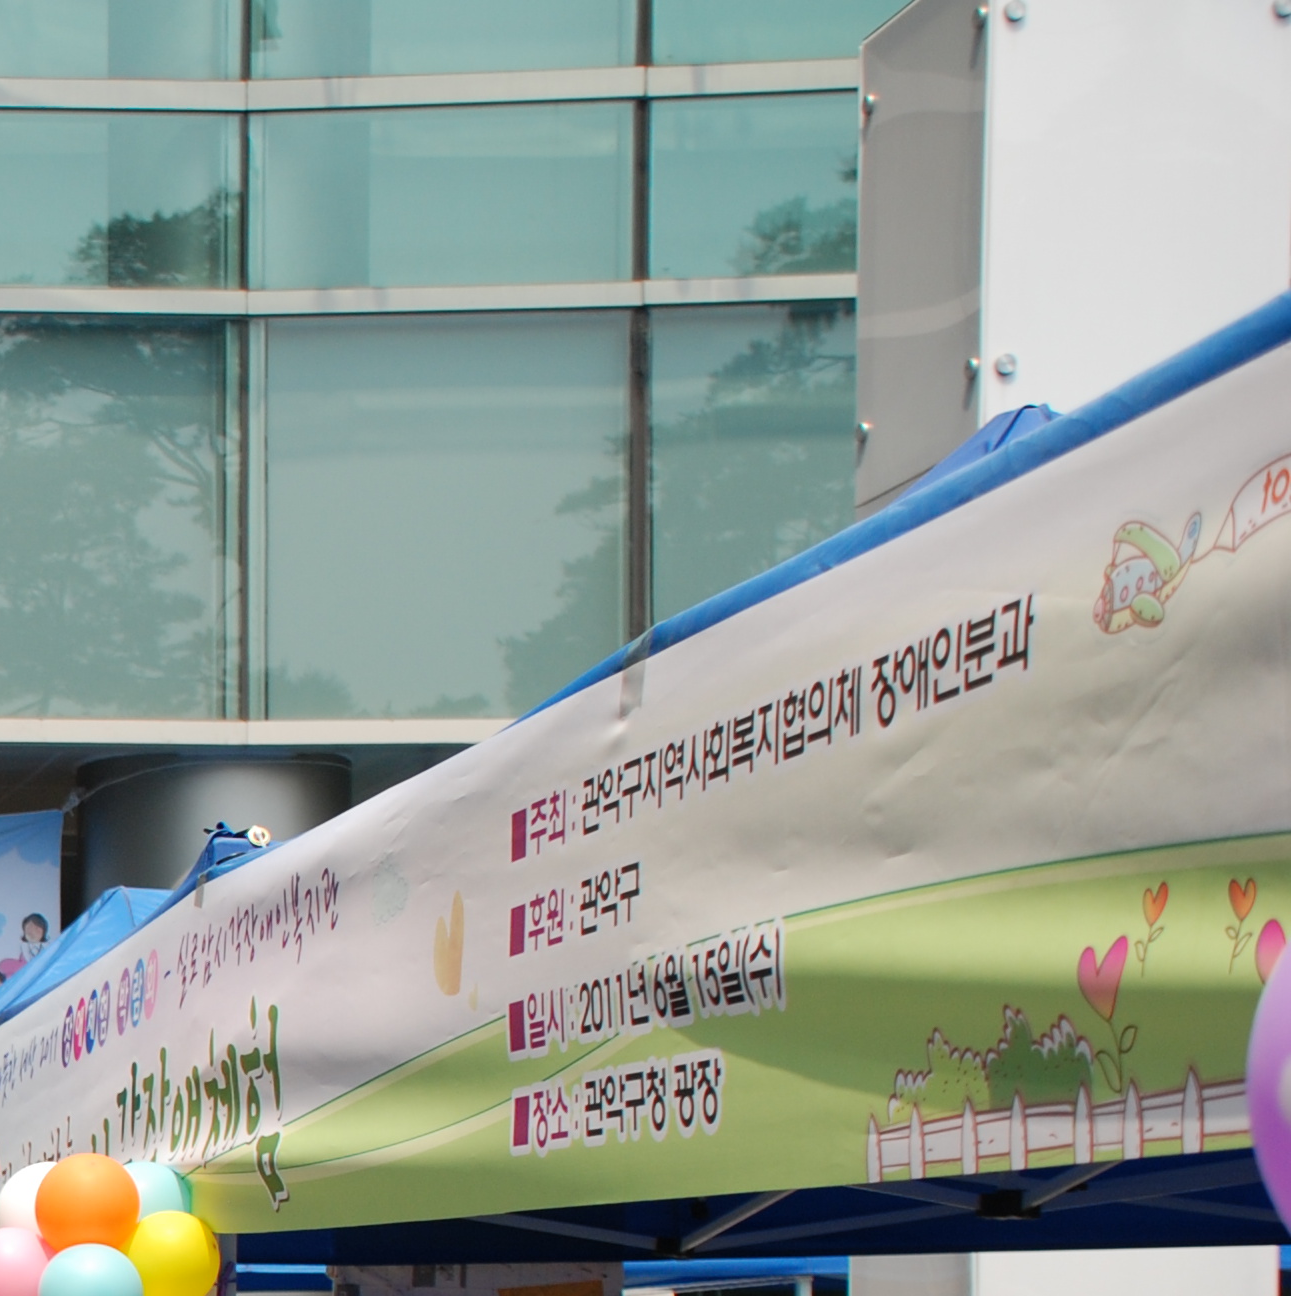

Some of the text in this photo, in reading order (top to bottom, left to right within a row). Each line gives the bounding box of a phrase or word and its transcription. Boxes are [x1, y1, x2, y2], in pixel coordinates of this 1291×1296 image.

[529, 594, 1035, 855] 주최: 관악구지역사회복지협의체 장애인분과
[579, 861, 641, 936] 관악구
[579, 963, 650, 1034] 2011년
[653, 953, 692, 1018] 6월
[692, 927, 783, 1009] 15일(수)
[584, 1065, 667, 1138] 관악구청
[673, 1057, 722, 1128] 광장
